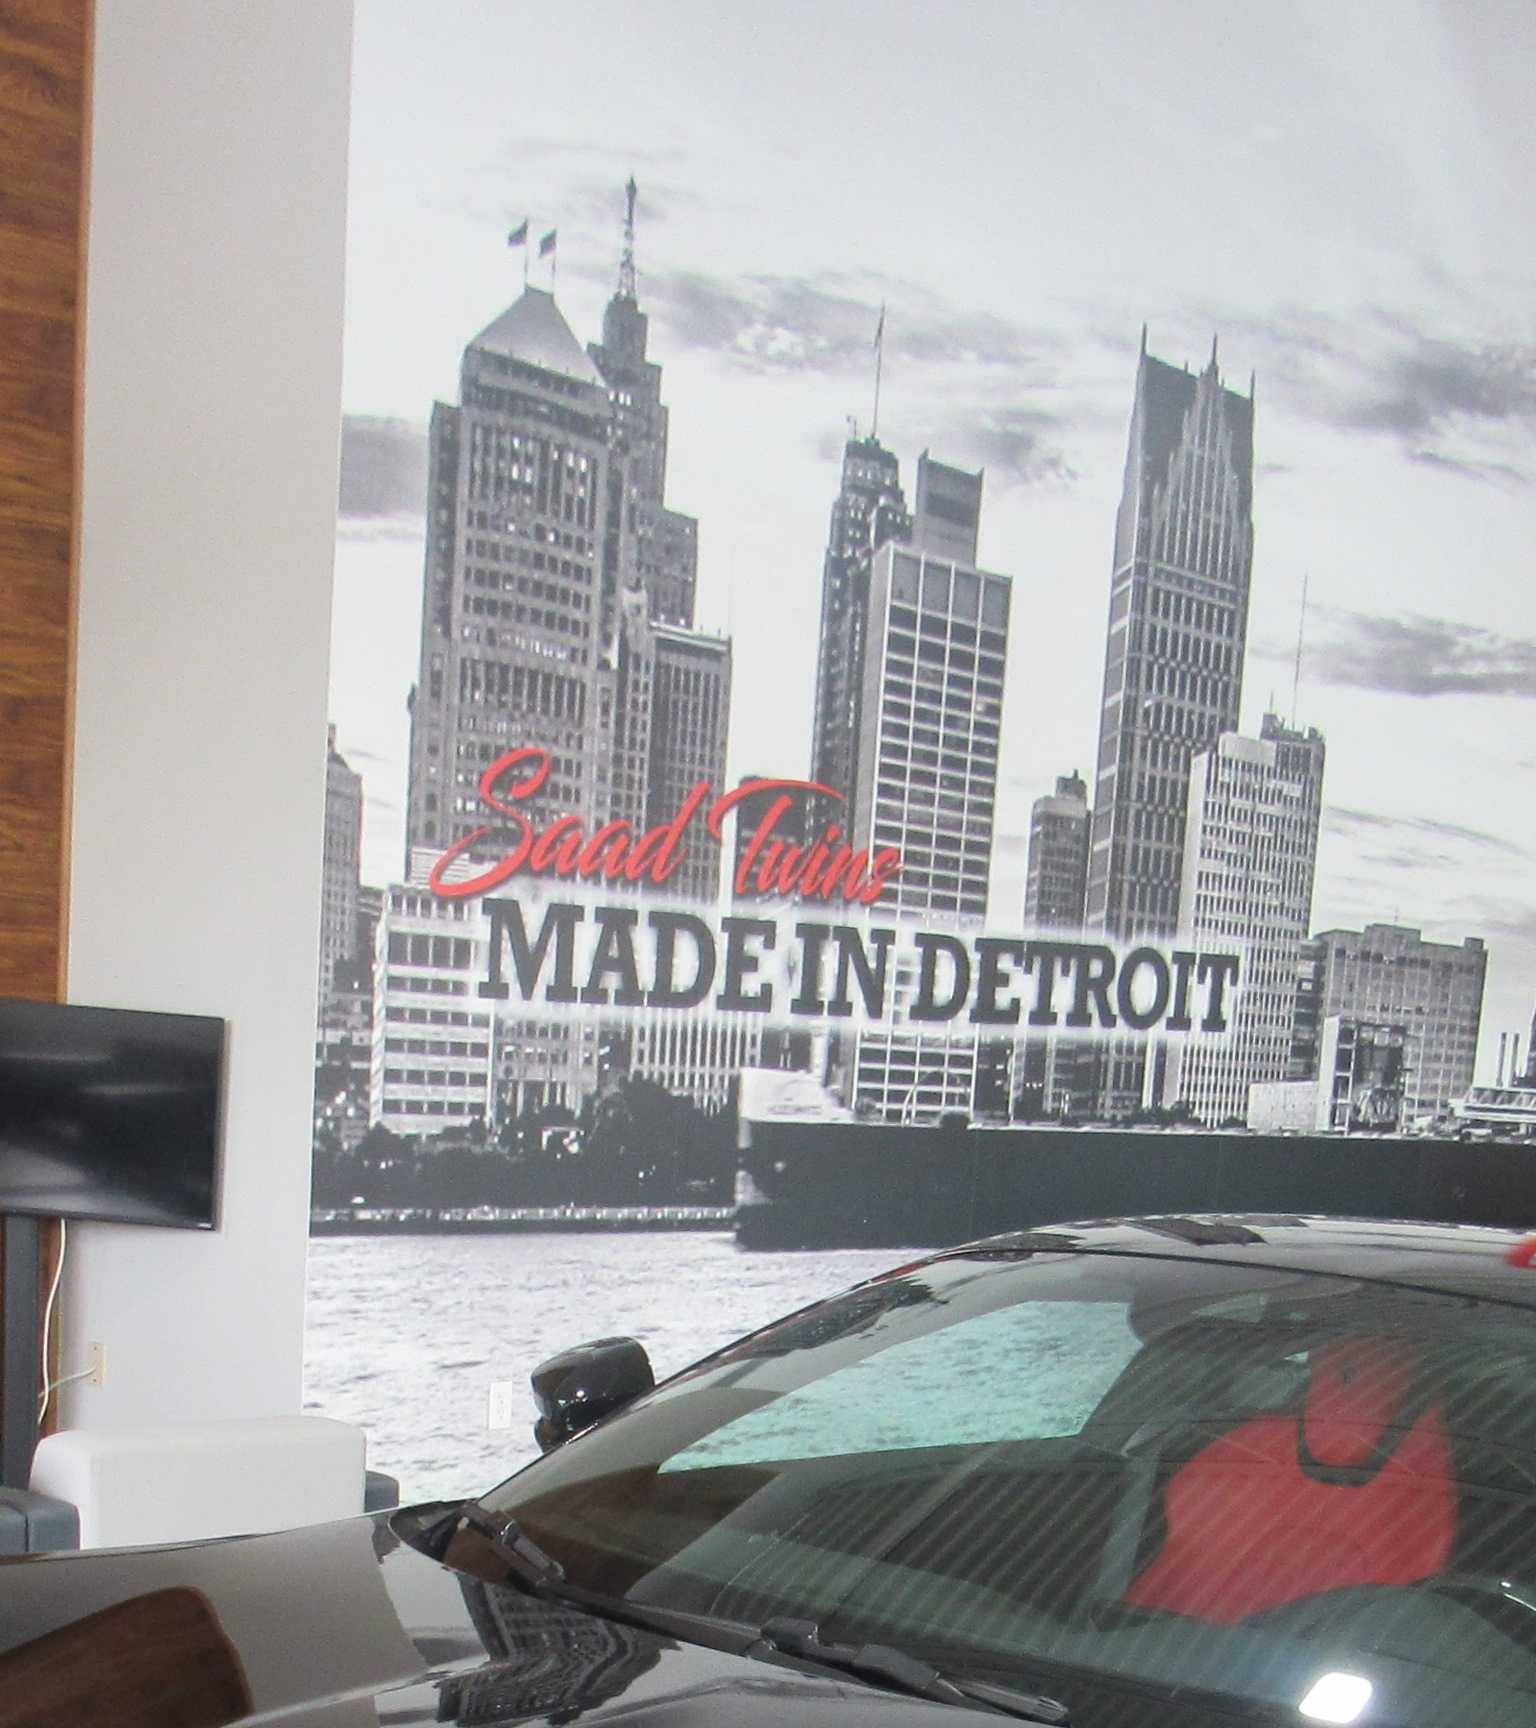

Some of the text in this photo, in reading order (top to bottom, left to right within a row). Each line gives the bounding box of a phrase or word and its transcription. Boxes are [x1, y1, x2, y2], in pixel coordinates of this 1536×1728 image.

[429, 747, 903, 905] Saad Twins
[478, 897, 1241, 1033] MADE IN DETROIT
